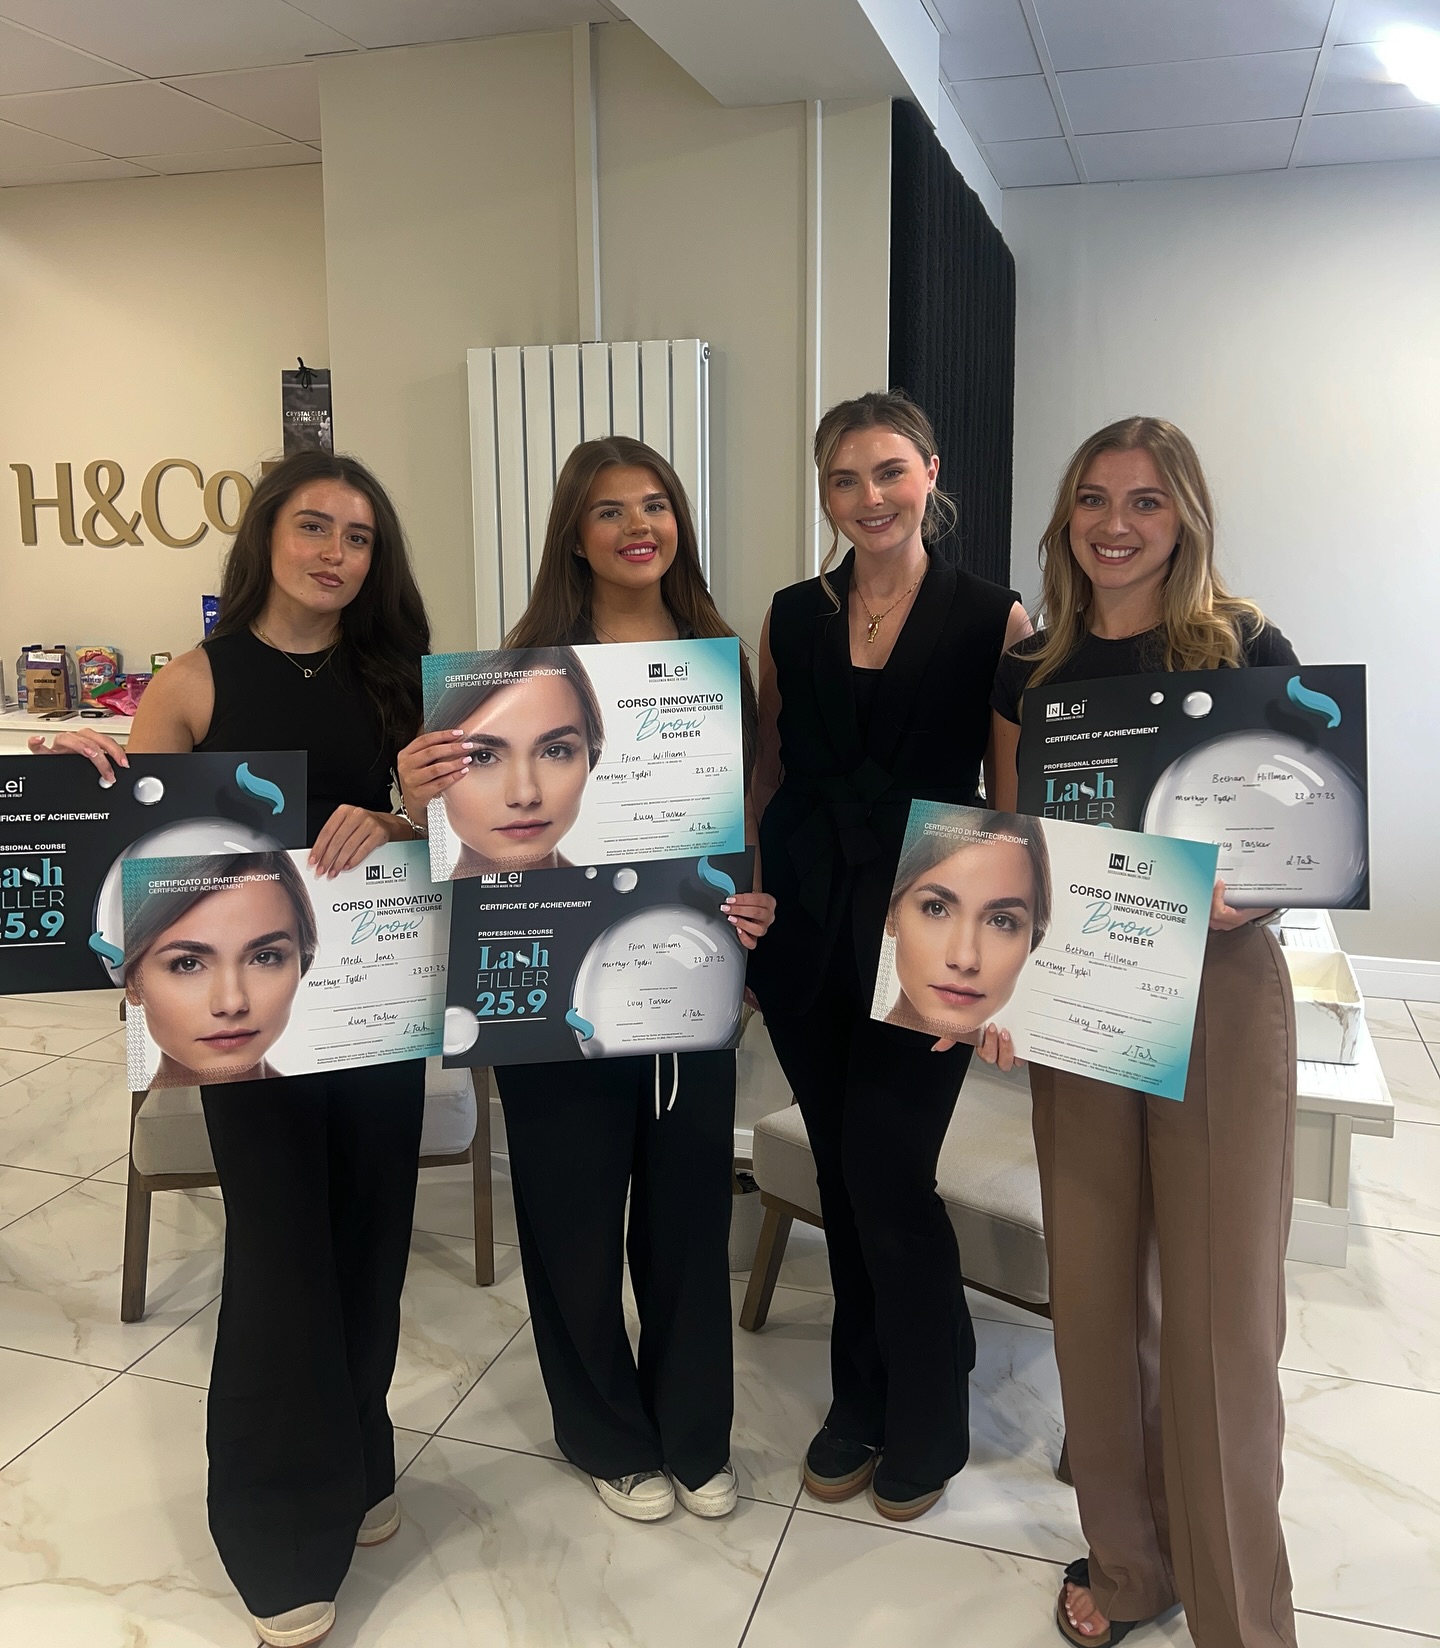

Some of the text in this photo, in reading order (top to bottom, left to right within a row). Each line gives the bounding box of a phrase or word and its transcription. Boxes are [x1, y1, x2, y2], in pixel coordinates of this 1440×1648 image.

[445, 668, 567, 682] CERTIFICATO DI PARTECIPAZIONE
[492, 677, 533, 685] ACHIEVEMENT
[617, 693, 724, 709] CORSO INNOVATIVO
[660, 704, 723, 714] INNOVATIVE COURSE
[635, 707, 706, 741] Brow
[661, 730, 701, 740] BOMBER
[1045, 726, 1159, 744] CERTIFICATE OF ACHIEVEMENT
[653, 750, 687, 760] Williams
[1043, 757, 1118, 770] PROFESSIONAL COURSE
[1211, 772, 1294, 783] Bethan Hillman
[1044, 771, 1115, 803] Lash
[33, 813, 46, 821] OF
[47, 812, 110, 821] ACHIEVEMENT
[1043, 801, 1115, 821] FILLER
[923, 829, 952, 839] CERTIFICATE
[960, 834, 997, 846] ACHIEVEMENT
[924, 822, 1029, 845] CERTIFICATO DI PARTECIPAZIONE
[0, 857, 64, 888] ash
[148, 873, 280, 888] CERTIFICATO DI PARTECIPAZIONE
[200, 883, 244, 891] ACHIEVEMENT
[332, 893, 442, 912] CORSO INNOVATIVO
[480, 902, 527, 911] CERTIFICATE
[540, 900, 592, 909] ACHIEVEMENT
[1069, 884, 1188, 915] CORSO INNOVATIVO
[377, 904, 442, 916] INNOVATIVE COURSE
[1113, 904, 1187, 924] INNOVATIVE COURSE
[0, 910, 65, 939] 5.9
[351, 910, 424, 945] Brow
[1081, 901, 1163, 937] Brow
[377, 931, 418, 942] BOMBER
[527, 928, 554, 936] COURSE
[1109, 931, 1154, 948] BOMBER
[652, 942, 681, 950] Williams
[375, 953, 395, 963] Jones
[478, 941, 549, 971] Lash
[1065, 943, 1095, 958] Bethan
[1103, 951, 1138, 967] Hillman
[476, 970, 549, 989] FILLER
[475, 989, 548, 1017] 25.9
